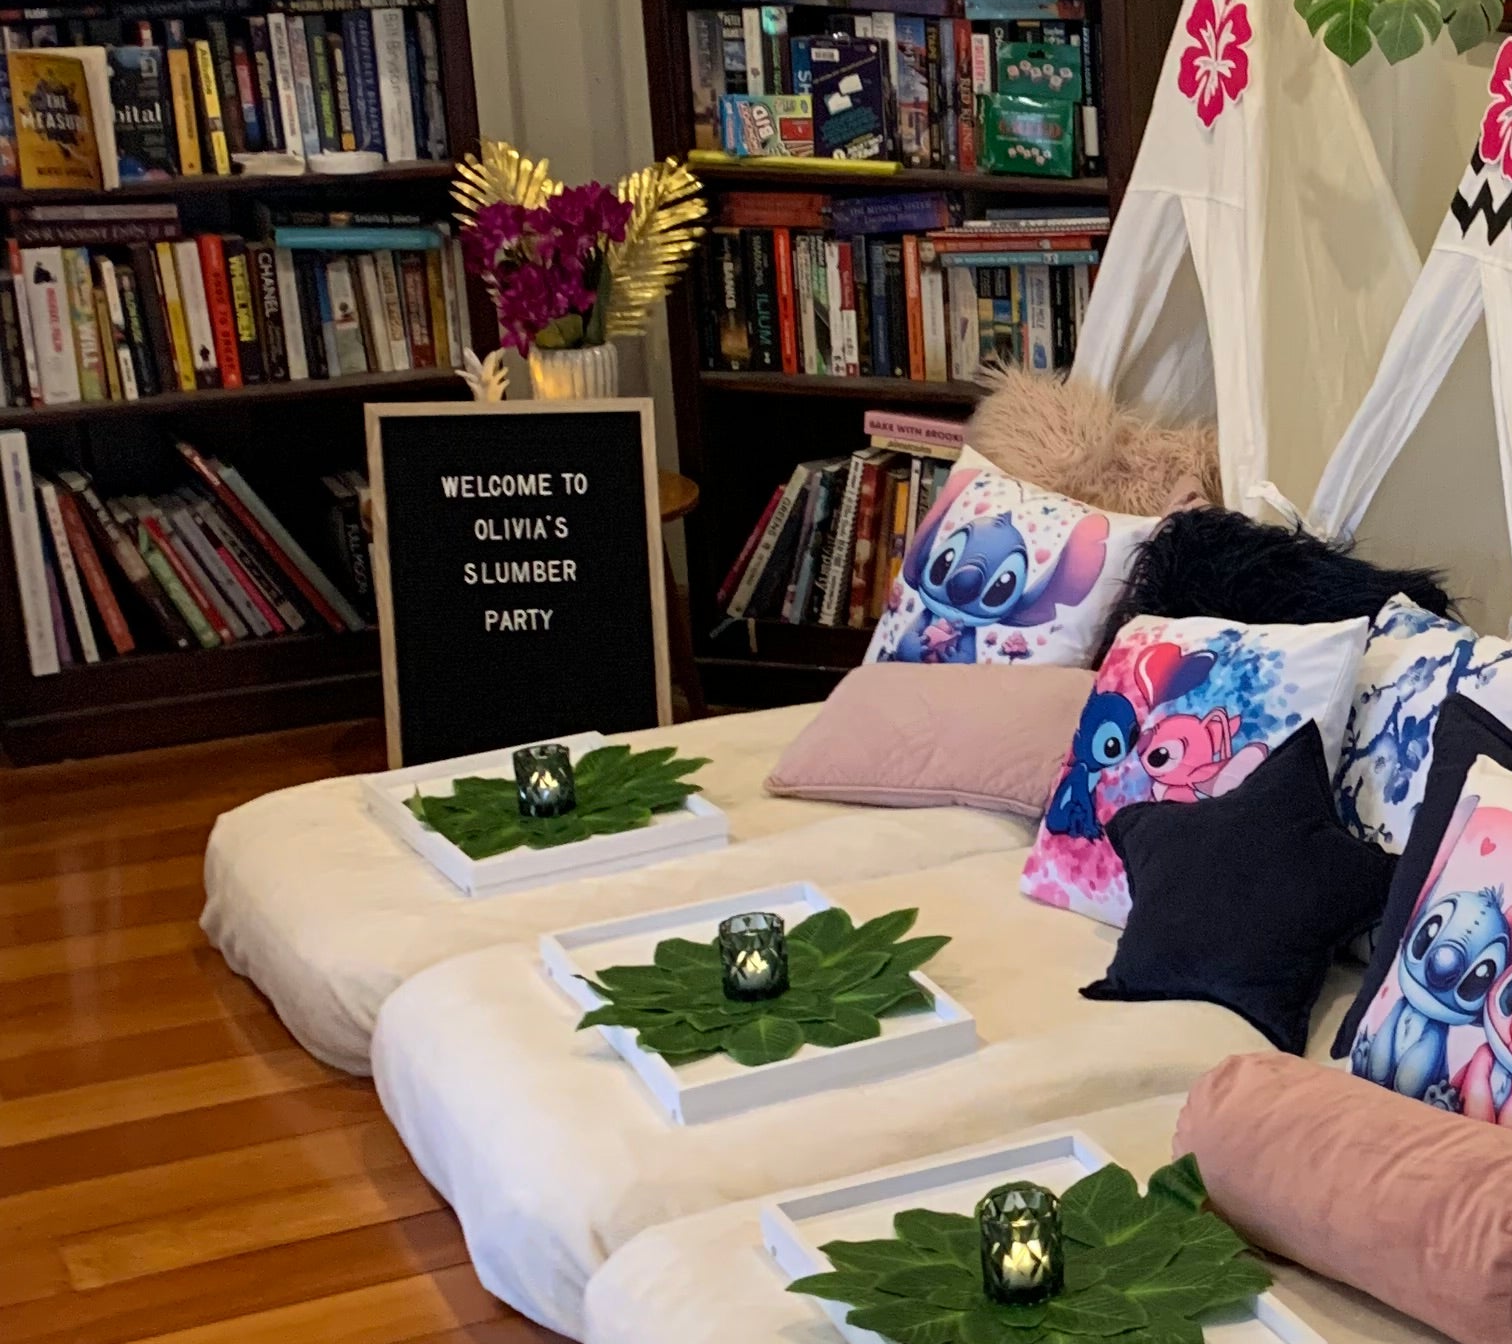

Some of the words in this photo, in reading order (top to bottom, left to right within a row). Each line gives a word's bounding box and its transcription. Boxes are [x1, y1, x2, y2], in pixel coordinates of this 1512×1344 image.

[383, 12, 399, 36] Bill
[386, 40, 403, 96] Bryson
[959, 76, 972, 104] RED
[960, 107, 974, 151] RISING
[257, 251, 279, 318] CHANEL
[723, 261, 736, 309] BANKS
[219, 310, 230, 326] TO
[756, 293, 772, 345] ILIUM
[78, 320, 99, 369] WILL
[869, 420, 894, 432] BAKE
[897, 425, 922, 435] WITH
[441, 474, 552, 498] WELCOME
[561, 473, 588, 496] TO
[474, 515, 569, 541] OLIVIA'S
[463, 559, 577, 585] SLUMBER
[485, 608, 554, 632] PARTY
